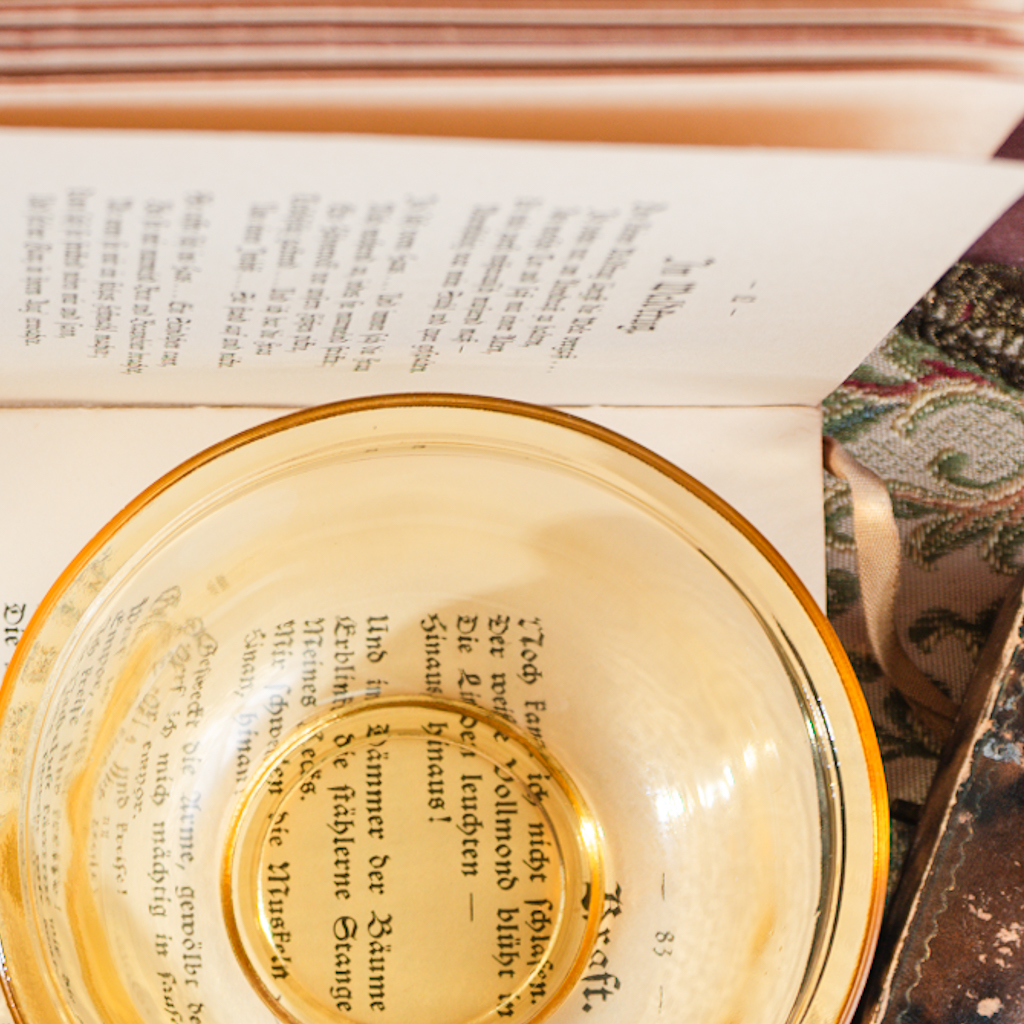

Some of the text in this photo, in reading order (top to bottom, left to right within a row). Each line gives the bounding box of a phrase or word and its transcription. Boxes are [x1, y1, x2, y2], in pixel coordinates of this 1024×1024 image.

[273, 620, 296, 671] Mir
[300, 618, 325, 708] Meines
[364, 615, 389, 663] Und
[456, 614, 478, 654] Die
[487, 614, 511, 659] Der
[517, 617, 546, 685] Noch
[491, 672, 518, 743] weie
[421, 722, 452, 823] hinaus!
[523, 773, 551, 807] ich
[456, 774, 483, 877] leuchten
[523, 822, 551, 883] nicht
[368, 855, 391, 895] der
[329, 916, 358, 1012] Stange
[367, 911, 392, 1012] Bäume
[492, 907, 521, 978] blüht
[582, 882, 623, 1013] Kraft.
[653, 930, 676, 957] 83
